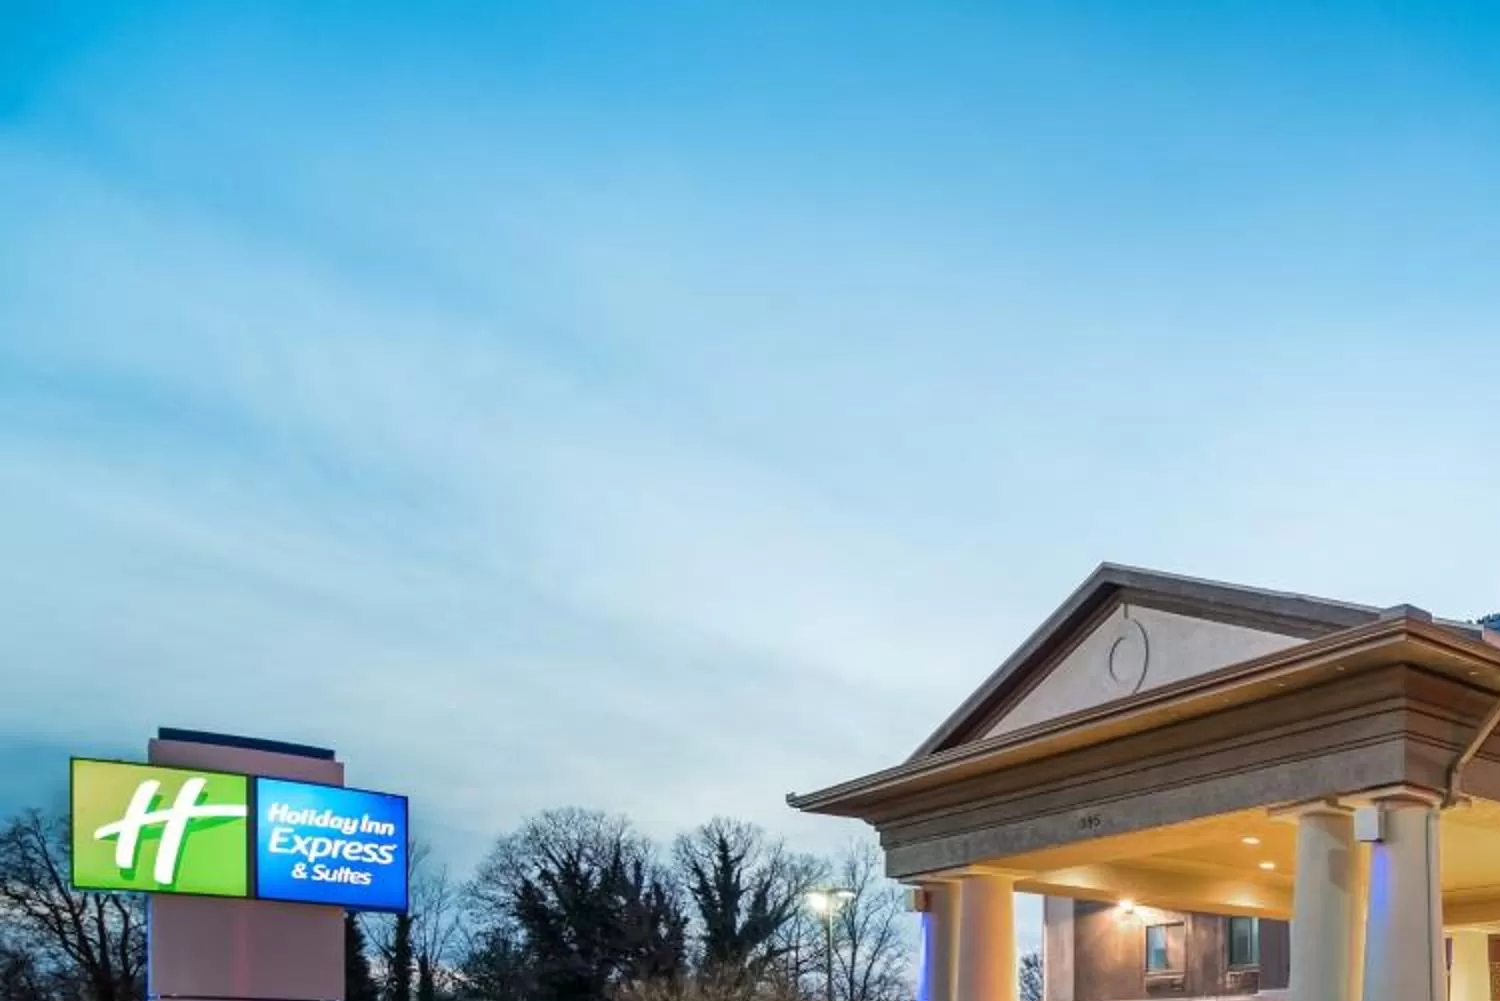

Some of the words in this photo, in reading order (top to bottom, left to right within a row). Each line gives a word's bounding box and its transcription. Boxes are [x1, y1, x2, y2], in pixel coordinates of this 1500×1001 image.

[267, 803, 358, 835] Holiday
[360, 814, 395, 836] Inn
[268, 828, 397, 864] Express
[291, 863, 307, 879] &
[311, 864, 373, 885] Suites
